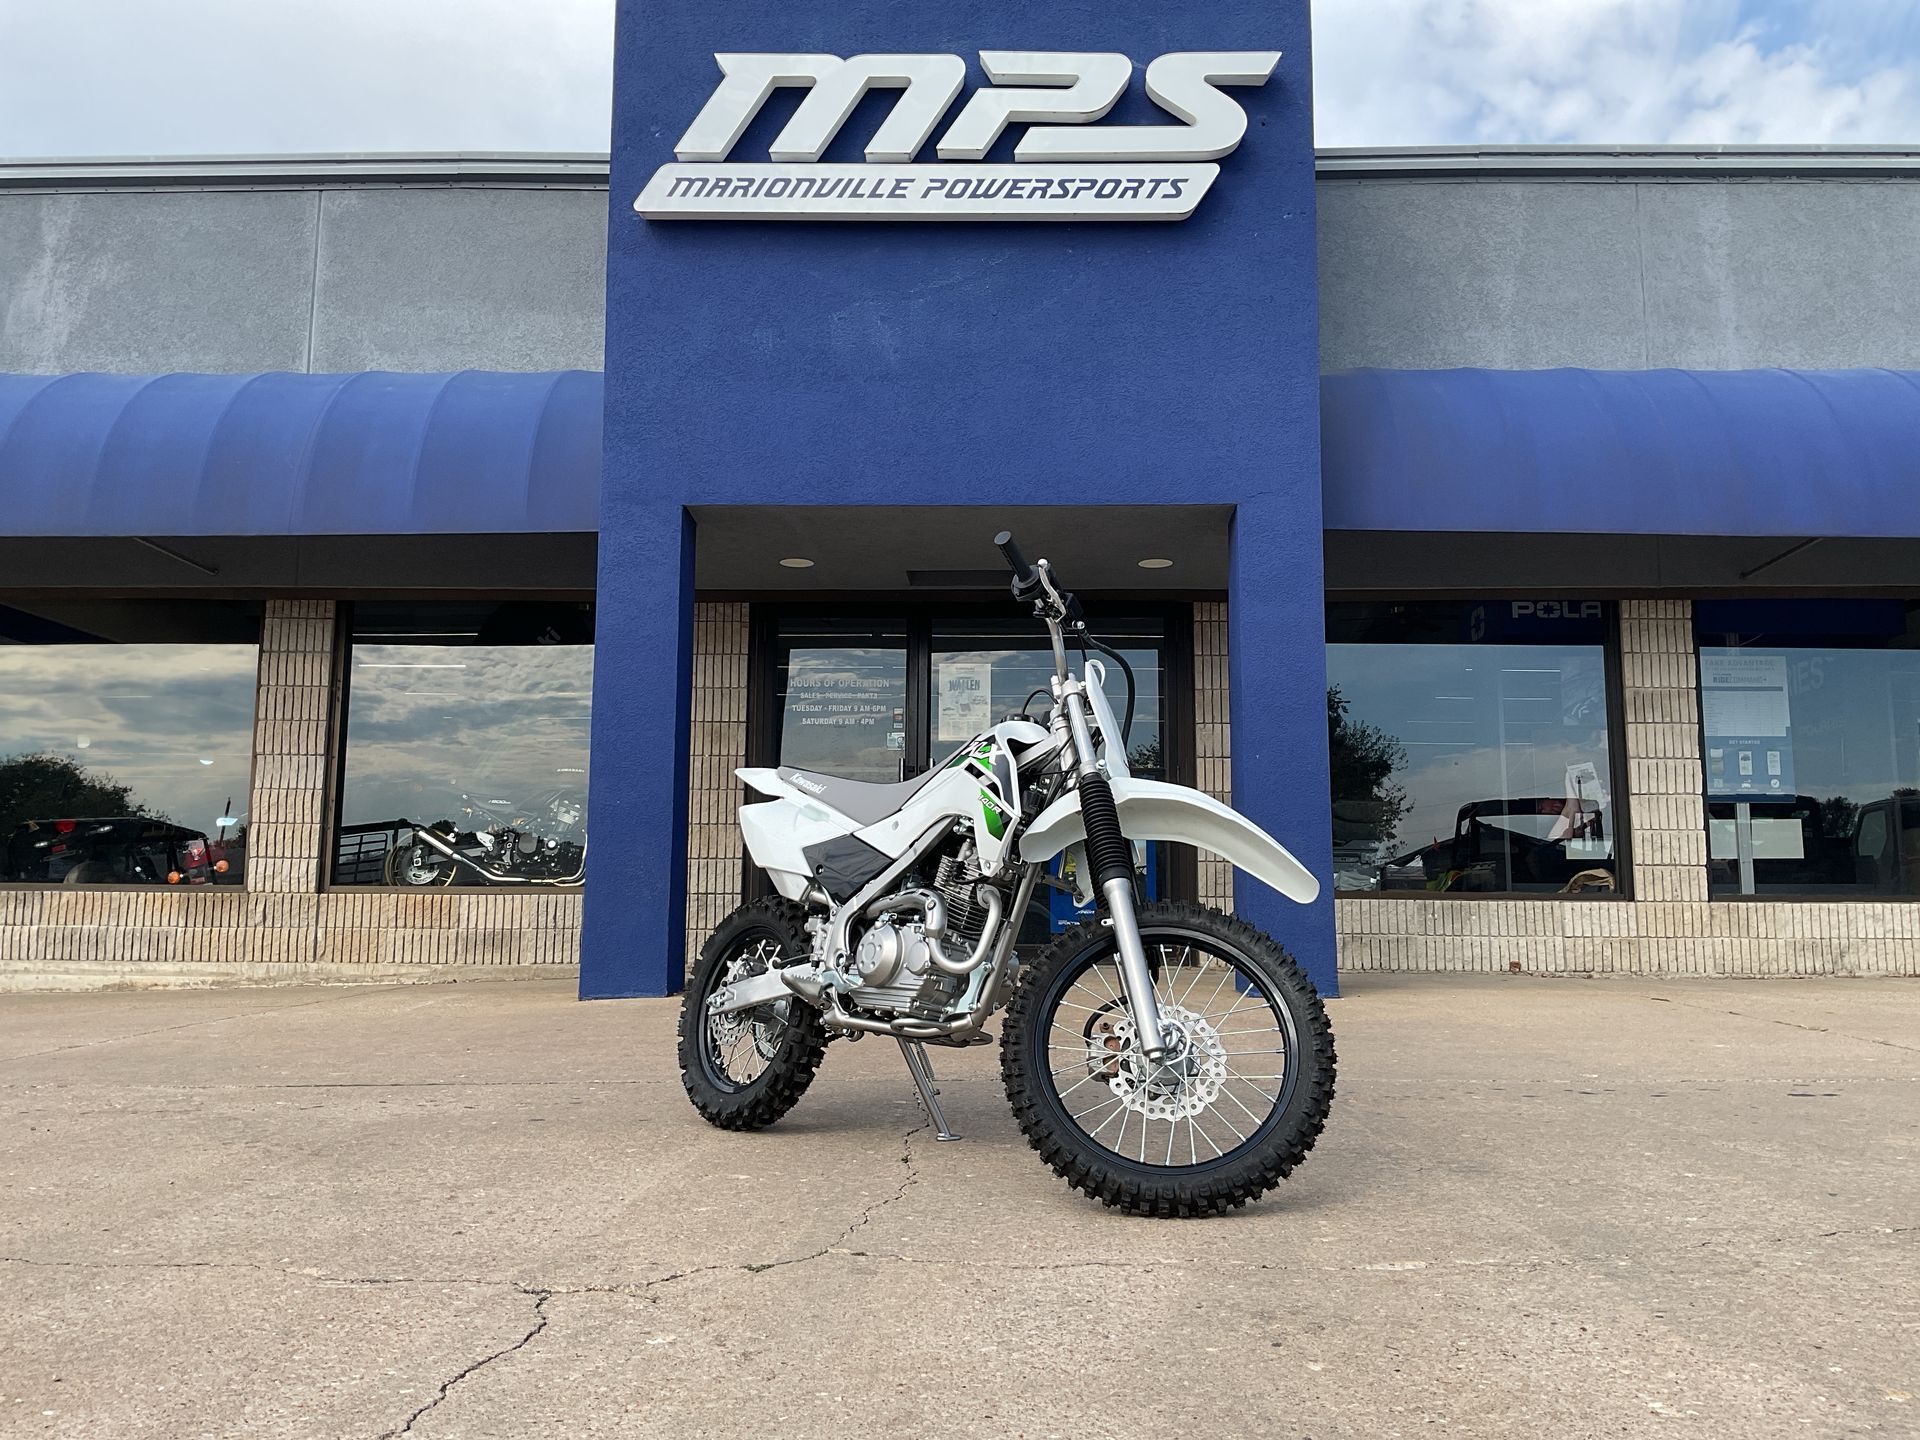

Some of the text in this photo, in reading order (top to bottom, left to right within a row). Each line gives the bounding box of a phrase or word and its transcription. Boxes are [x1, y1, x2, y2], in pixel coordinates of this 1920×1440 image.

[674, 50, 1283, 162] MPS
[665, 177, 1190, 200] MARIONVILLE POWERSPORTS
[790, 679, 890, 688] HOURS OF OPERATION
[791, 704, 823, 712] TUESDAY
[828, 704, 852, 712] FRIDAY
[853, 704, 858, 712] 9
[802, 717, 837, 725] SATURDAY
[838, 717, 843, 725] 9
[844, 717, 855, 725] AM
[860, 717, 875, 725] 4PM
[789, 772, 829, 794] Kawasaki
[978, 794, 1003, 815] 140R
